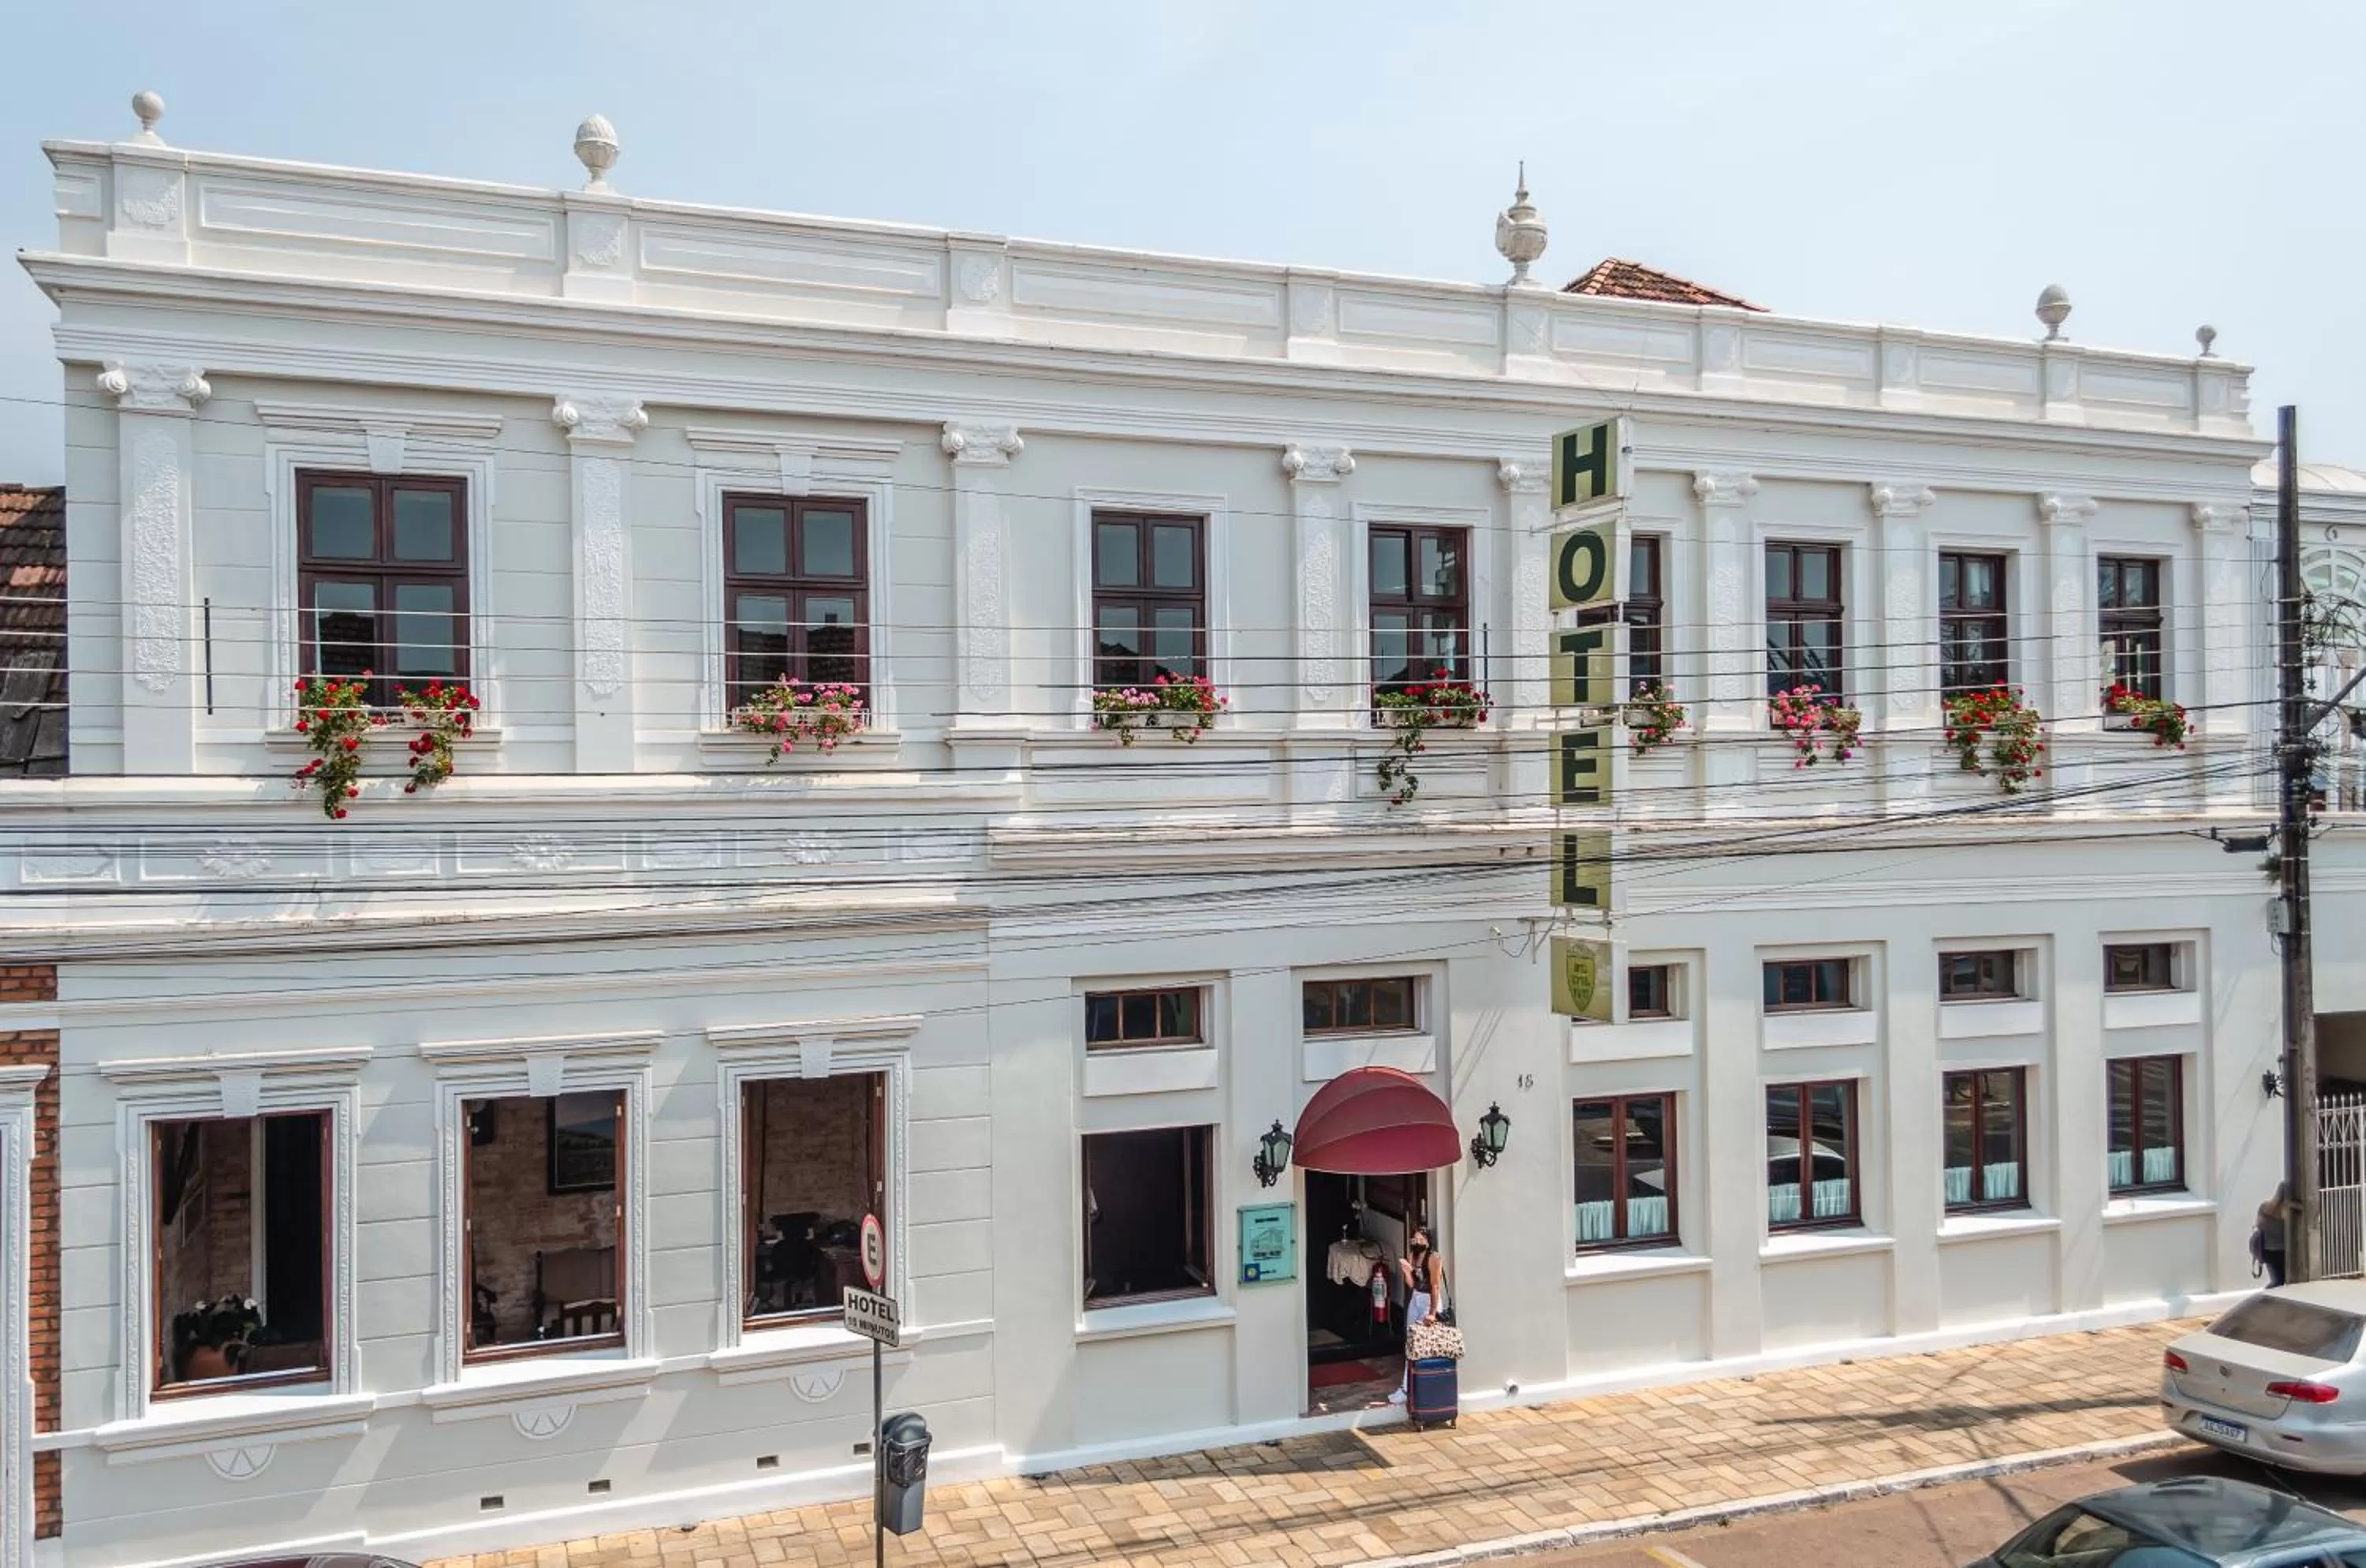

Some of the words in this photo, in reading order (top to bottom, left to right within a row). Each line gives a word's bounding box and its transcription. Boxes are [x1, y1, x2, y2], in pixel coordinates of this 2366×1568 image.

[1558, 424, 1607, 907] HOTEL
[867, 1233, 877, 1266] E
[848, 1293, 894, 1323] HOTEL
[859, 1320, 895, 1340] MINUTOS
